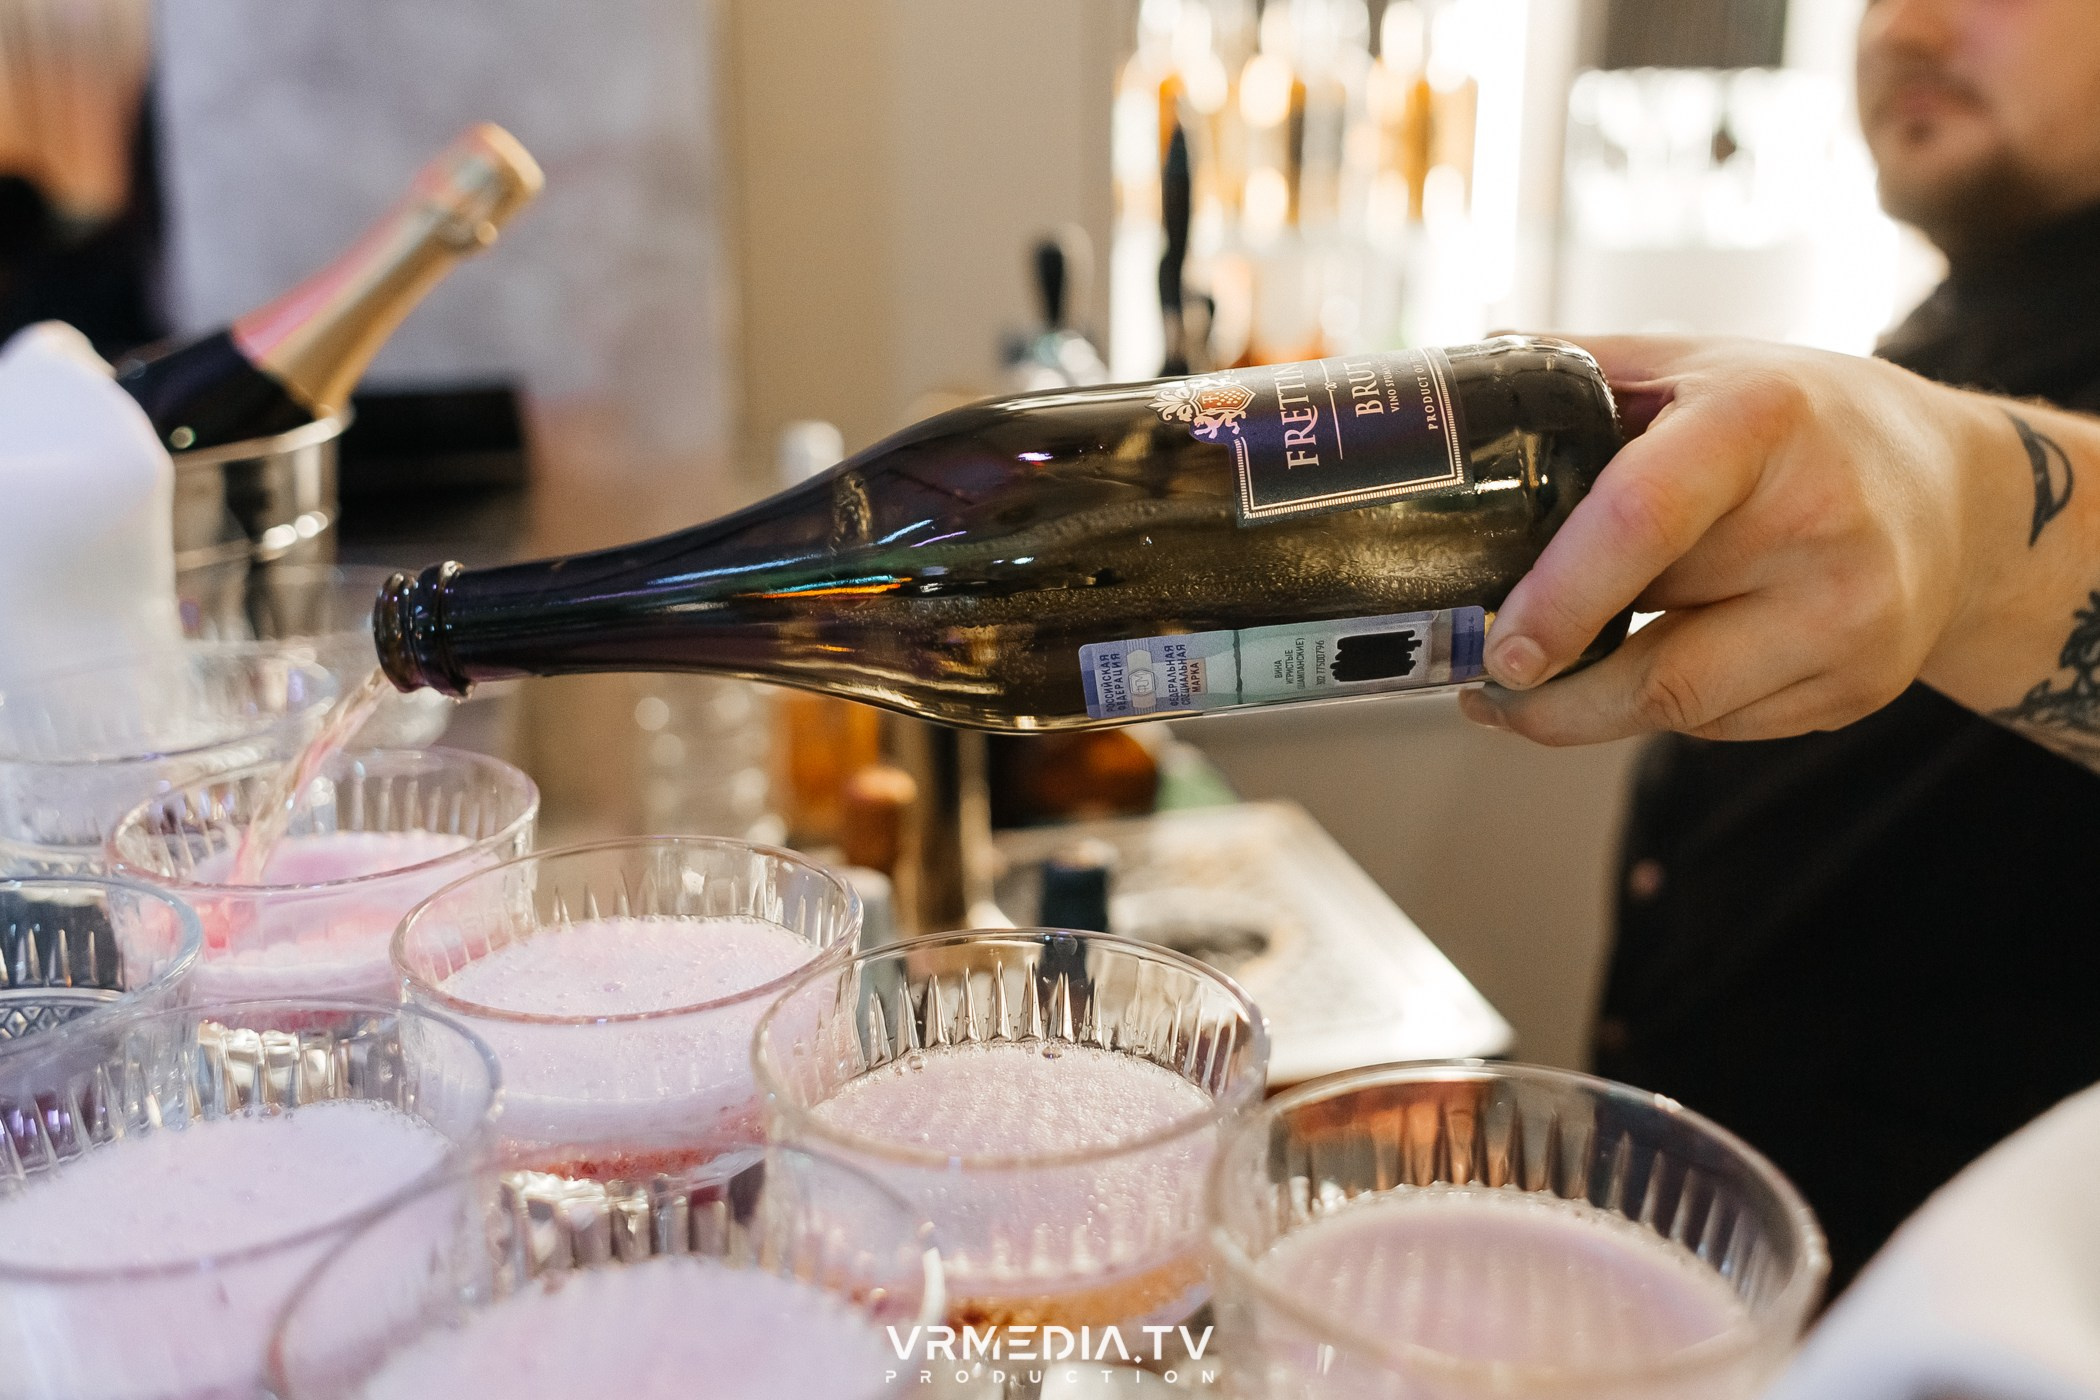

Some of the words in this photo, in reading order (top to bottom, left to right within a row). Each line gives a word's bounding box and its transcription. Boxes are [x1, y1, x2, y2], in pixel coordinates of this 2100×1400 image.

[1343, 360, 1384, 418] BRUT
[1387, 389, 1400, 413] VINO
[1416, 376, 1439, 431] PRODUCT
[1099, 654, 1116, 712] РОССИЙСКАЯ
[1110, 653, 1126, 711] ФЕДЕРАЦИЯ
[1164, 645, 1179, 707] ФЕДЕРАЛЬНАЯ
[1176, 644, 1191, 706] СПЕЦИАЛЬНАЯ
[1190, 662, 1201, 693] МАРКА
[1274, 659, 1283, 679] ВИНА
[1285, 649, 1294, 685] ИГРИСТЫЕ
